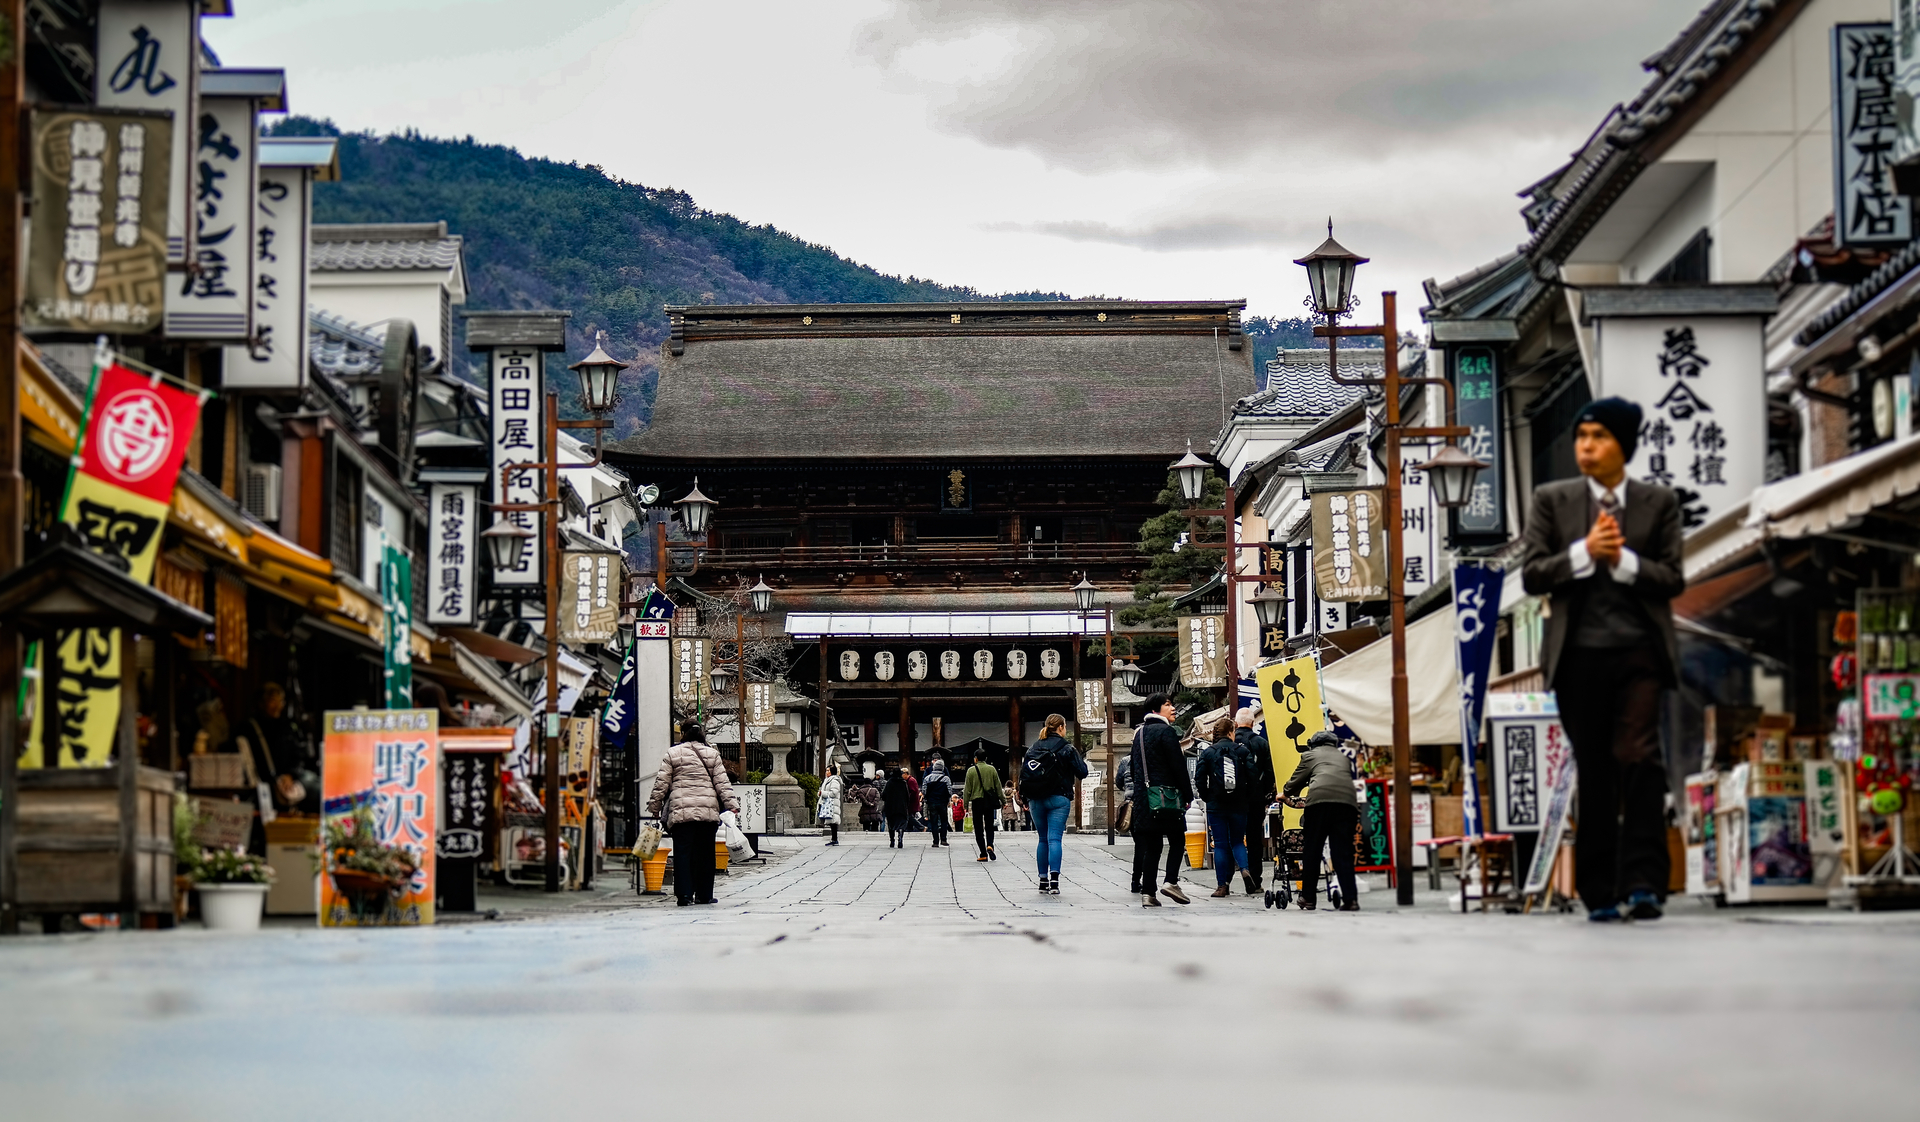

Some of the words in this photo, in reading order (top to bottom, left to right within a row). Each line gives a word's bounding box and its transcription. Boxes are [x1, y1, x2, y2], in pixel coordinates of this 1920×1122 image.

[1654, 326, 1713, 421] 落合
[1462, 424, 1495, 518] 佐藤
[1401, 457, 1425, 584] 信州屋
[640, 624, 667, 637] 歓迎
[470, 757, 488, 827] とんかつと
